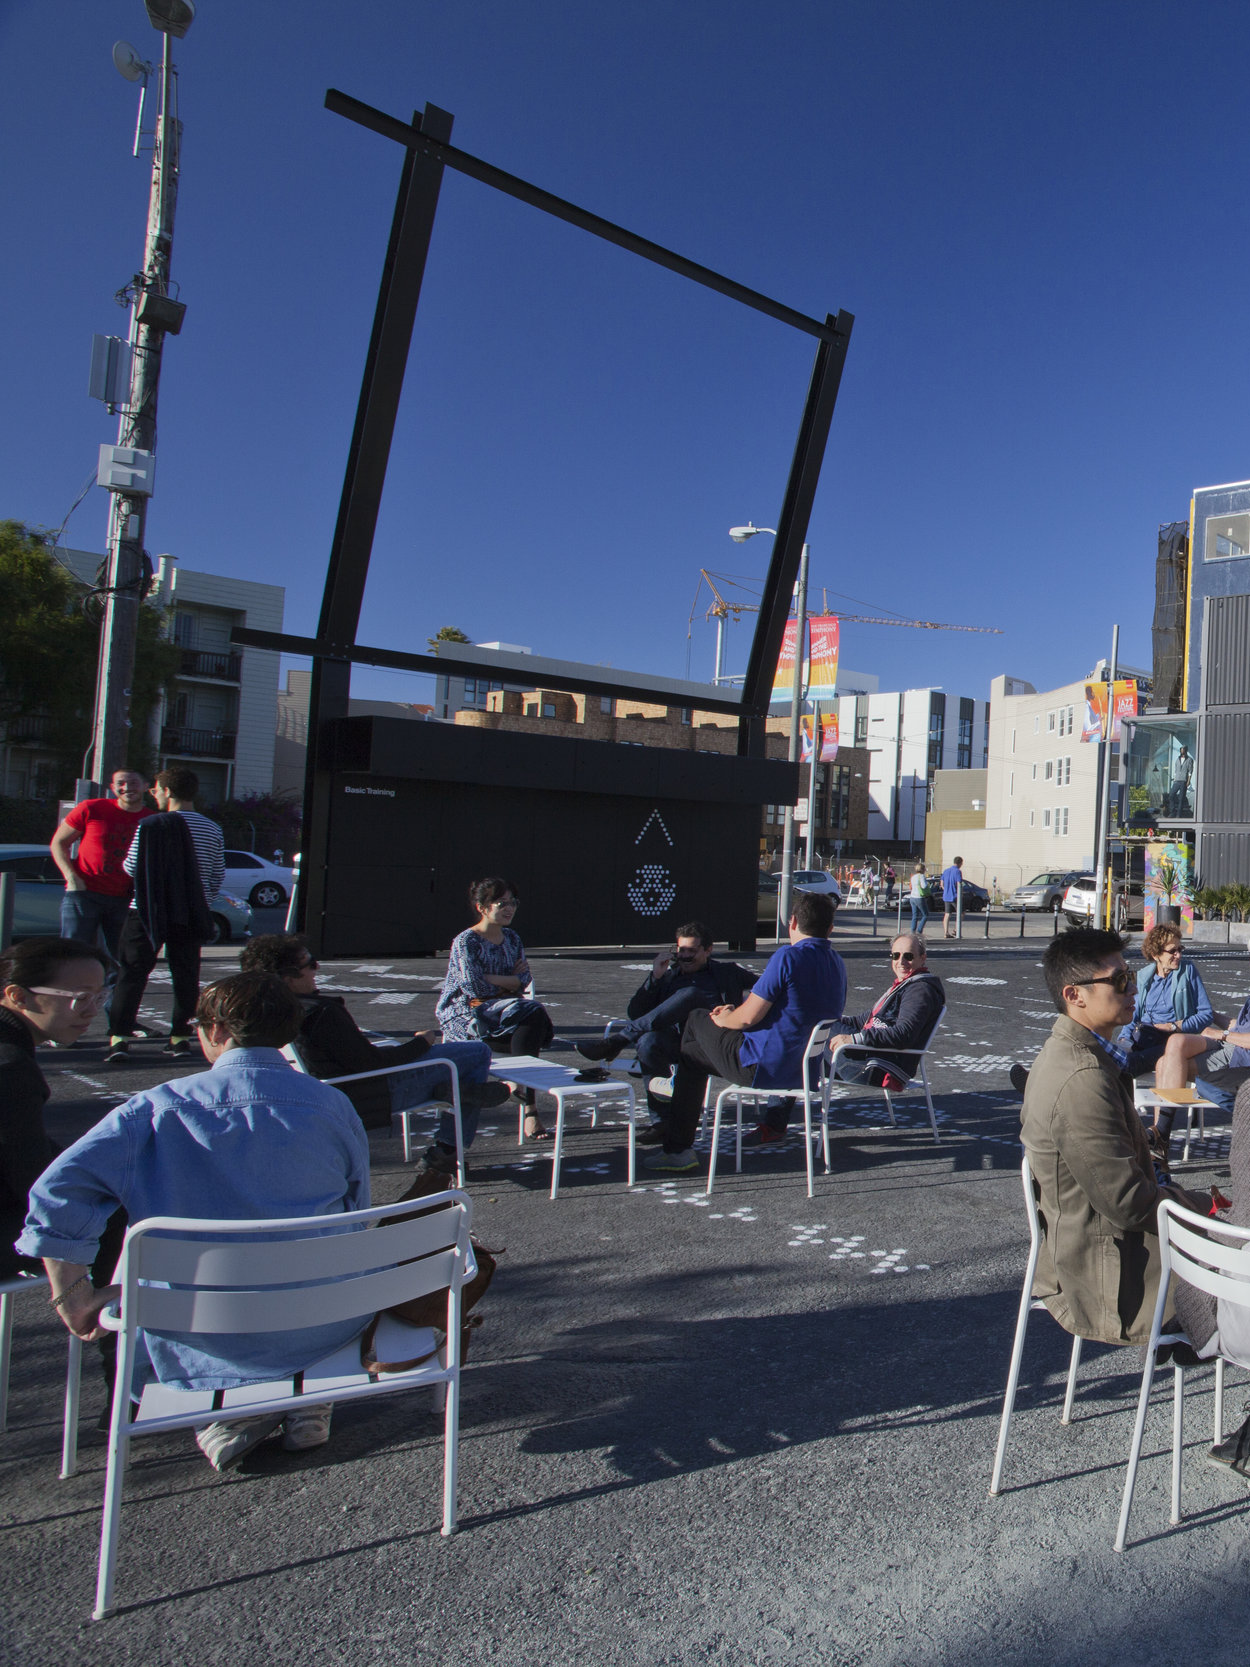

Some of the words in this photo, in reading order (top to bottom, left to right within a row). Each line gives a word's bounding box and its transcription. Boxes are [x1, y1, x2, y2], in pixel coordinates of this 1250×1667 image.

[1118, 697, 1134, 708] JAZZ
[345, 786, 366, 794] Basic
[366, 787, 396, 797] Training
